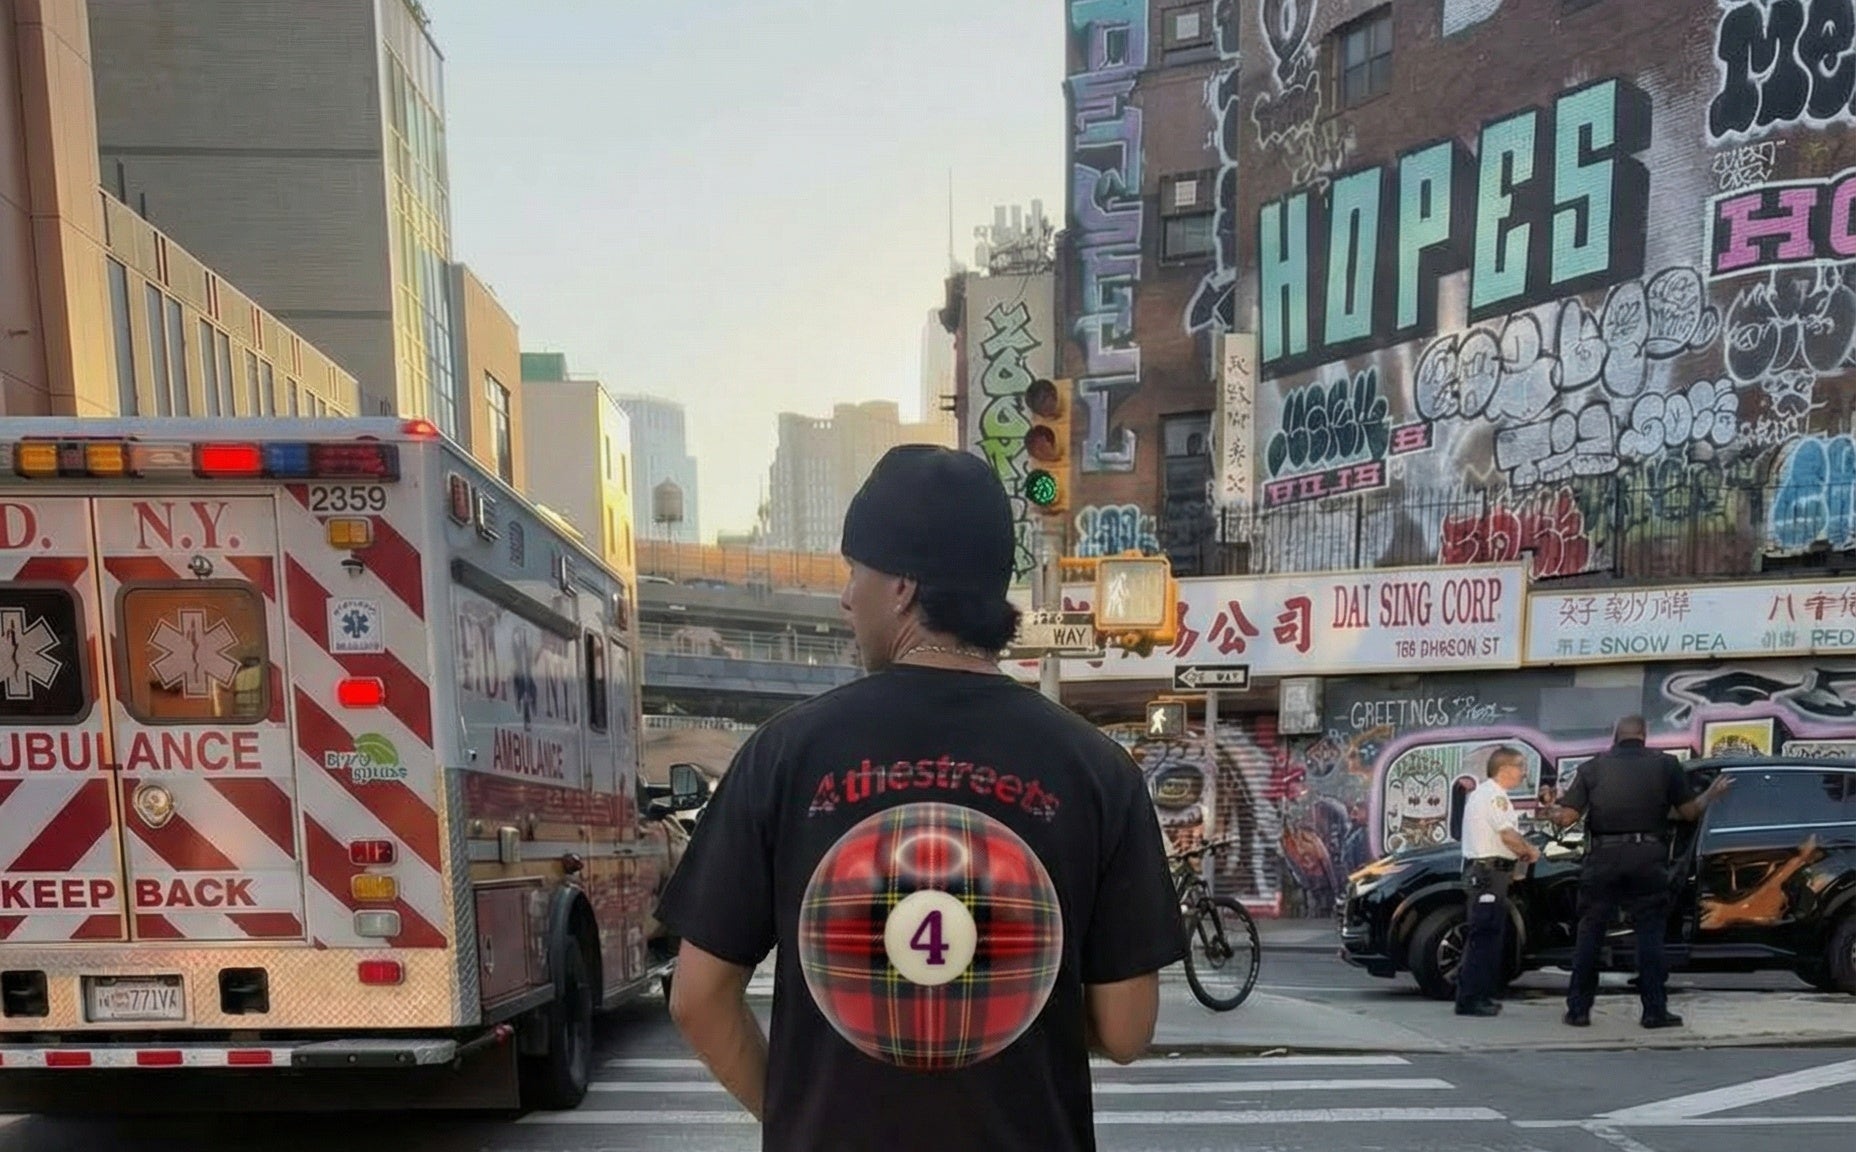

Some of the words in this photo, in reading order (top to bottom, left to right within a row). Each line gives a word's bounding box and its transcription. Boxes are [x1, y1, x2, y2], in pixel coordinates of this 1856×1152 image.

[1707, 0, 1856, 141] Me
[1259, 77, 1620, 366] HOPES
[311, 485, 387, 512] 2359
[132, 501, 240, 550] N.Y.
[1332, 584, 1371, 628] DAI
[1380, 580, 1432, 626] SING
[1053, 627, 1087, 646] WAY
[1482, 636, 1501, 655] ST
[1600, 635, 1670, 655] SNOW
[1681, 633, 1727, 651] PEA
[1, 879, 115, 908] KEEP
[135, 878, 257, 907] BACK
[909, 910, 949, 966] 4
